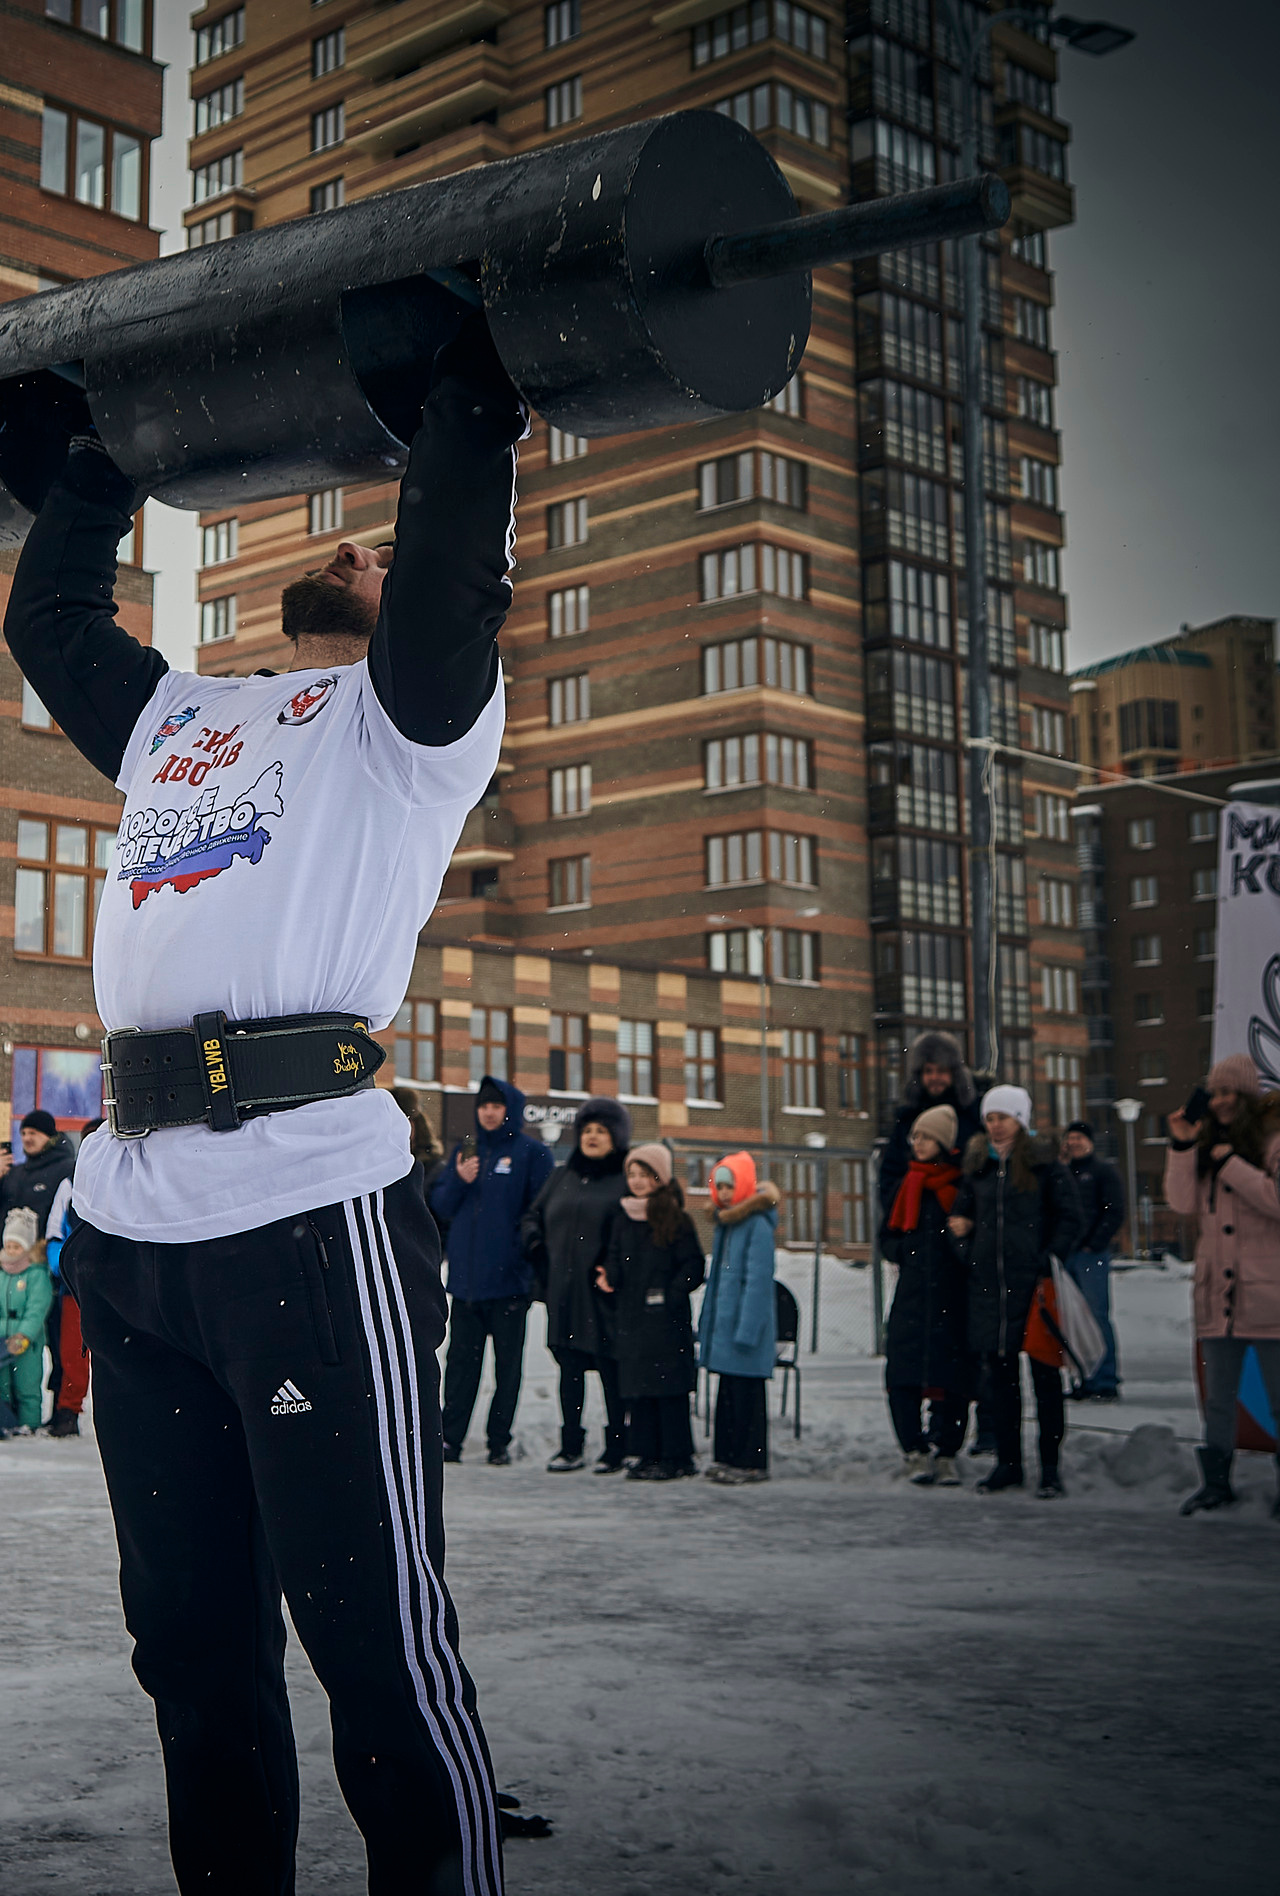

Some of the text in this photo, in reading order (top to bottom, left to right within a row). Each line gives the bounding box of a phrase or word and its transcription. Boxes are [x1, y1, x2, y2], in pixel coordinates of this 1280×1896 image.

[337, 1042, 358, 1064] Yeah
[203, 1038, 228, 1094] YBLWB
[272, 1401, 312, 1415] adidas
